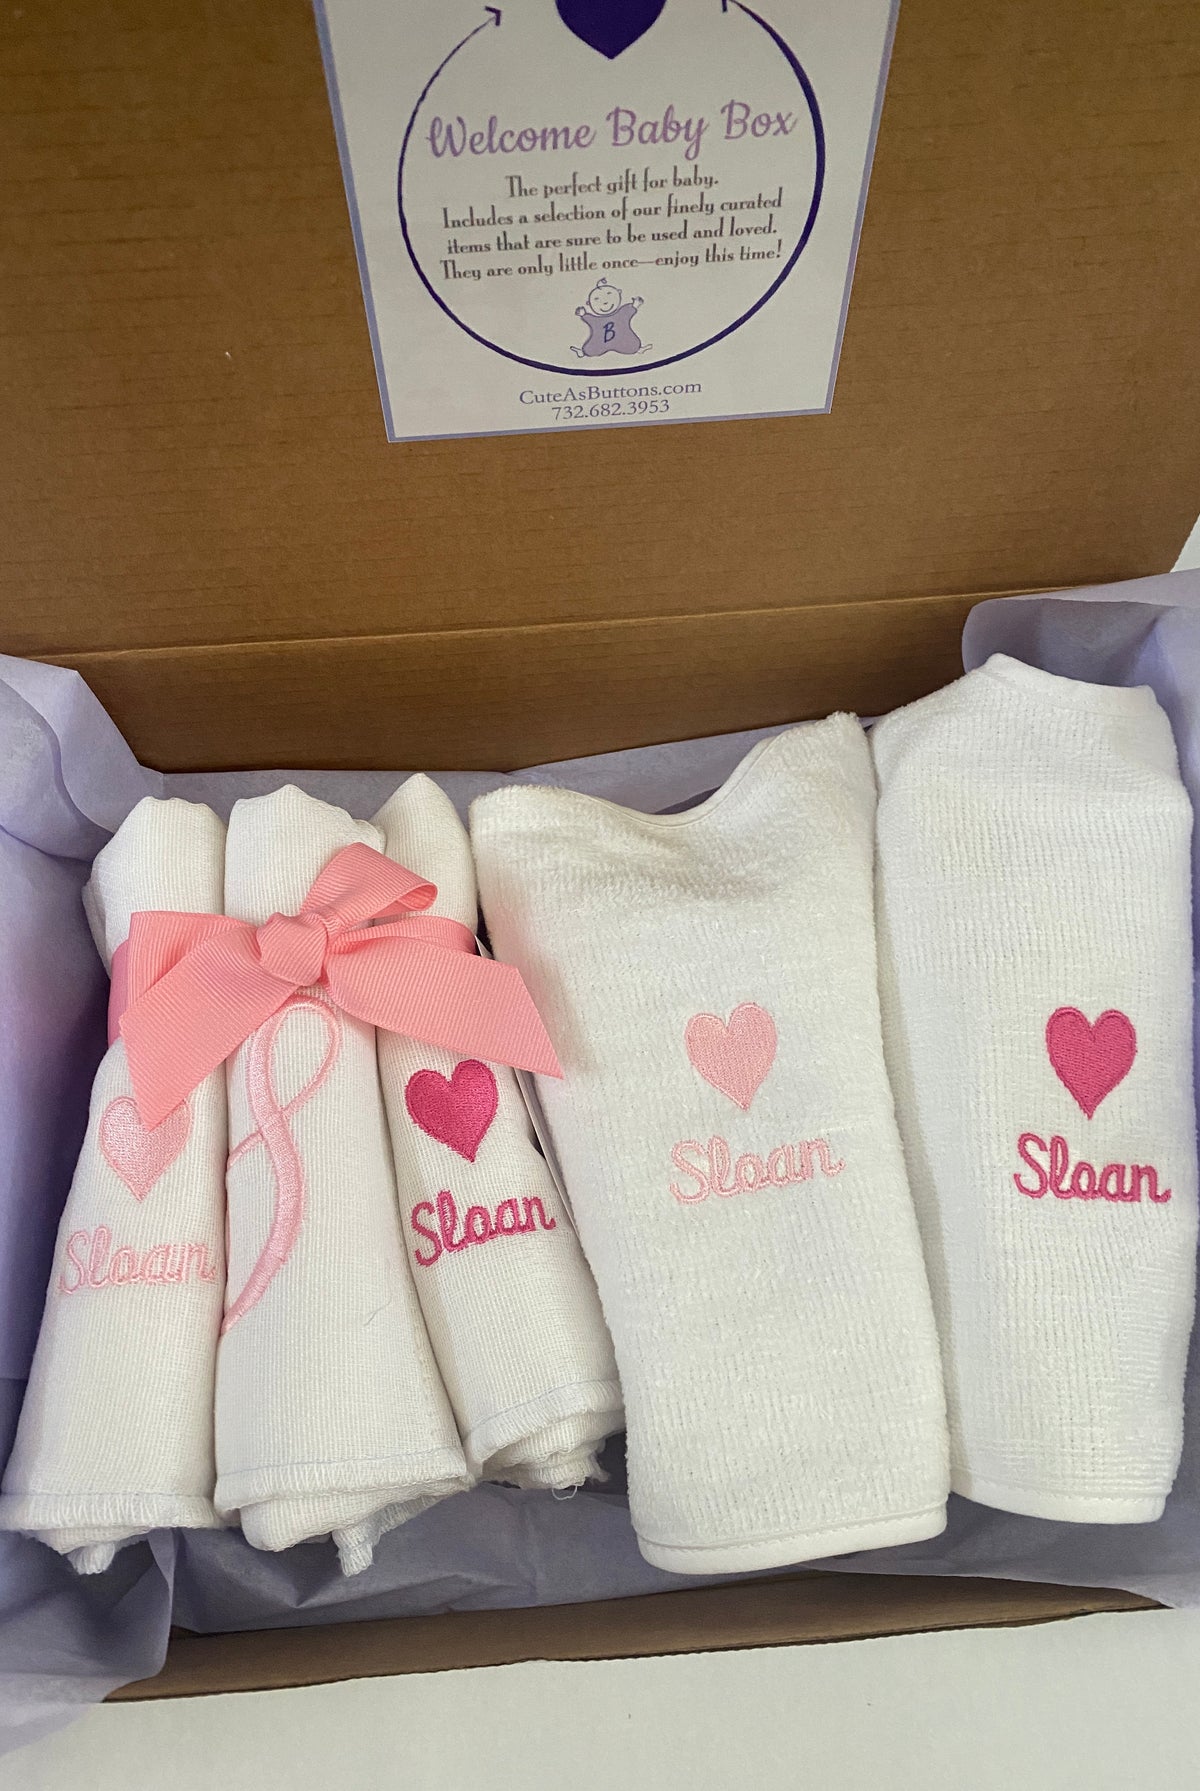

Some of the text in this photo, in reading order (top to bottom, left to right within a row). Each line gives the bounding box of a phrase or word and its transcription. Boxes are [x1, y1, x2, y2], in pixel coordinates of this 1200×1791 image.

[426, 99, 798, 160] Welcome Baby Box
[505, 165, 719, 199] The perfect gift for baby.
[443, 187, 782, 229] Includes a selection of our finely curated
[448, 213, 776, 255] items that are sure to be used and loved.
[440, 259, 481, 280] They
[487, 265, 513, 277] are
[517, 254, 553, 275] only
[559, 252, 598, 272] little
[705, 243, 734, 263] this
[740, 239, 782, 261] time!
[603, 323, 616, 343] B
[519, 382, 702, 405] CuteAsButtons.com
[552, 400, 668, 420] 732.682.3953
[669, 1136, 846, 1205] Sloan
[1013, 1133, 1171, 1203] Sloan
[411, 1190, 556, 1267] Sloan
[58, 1226, 216, 1295] Sloan
